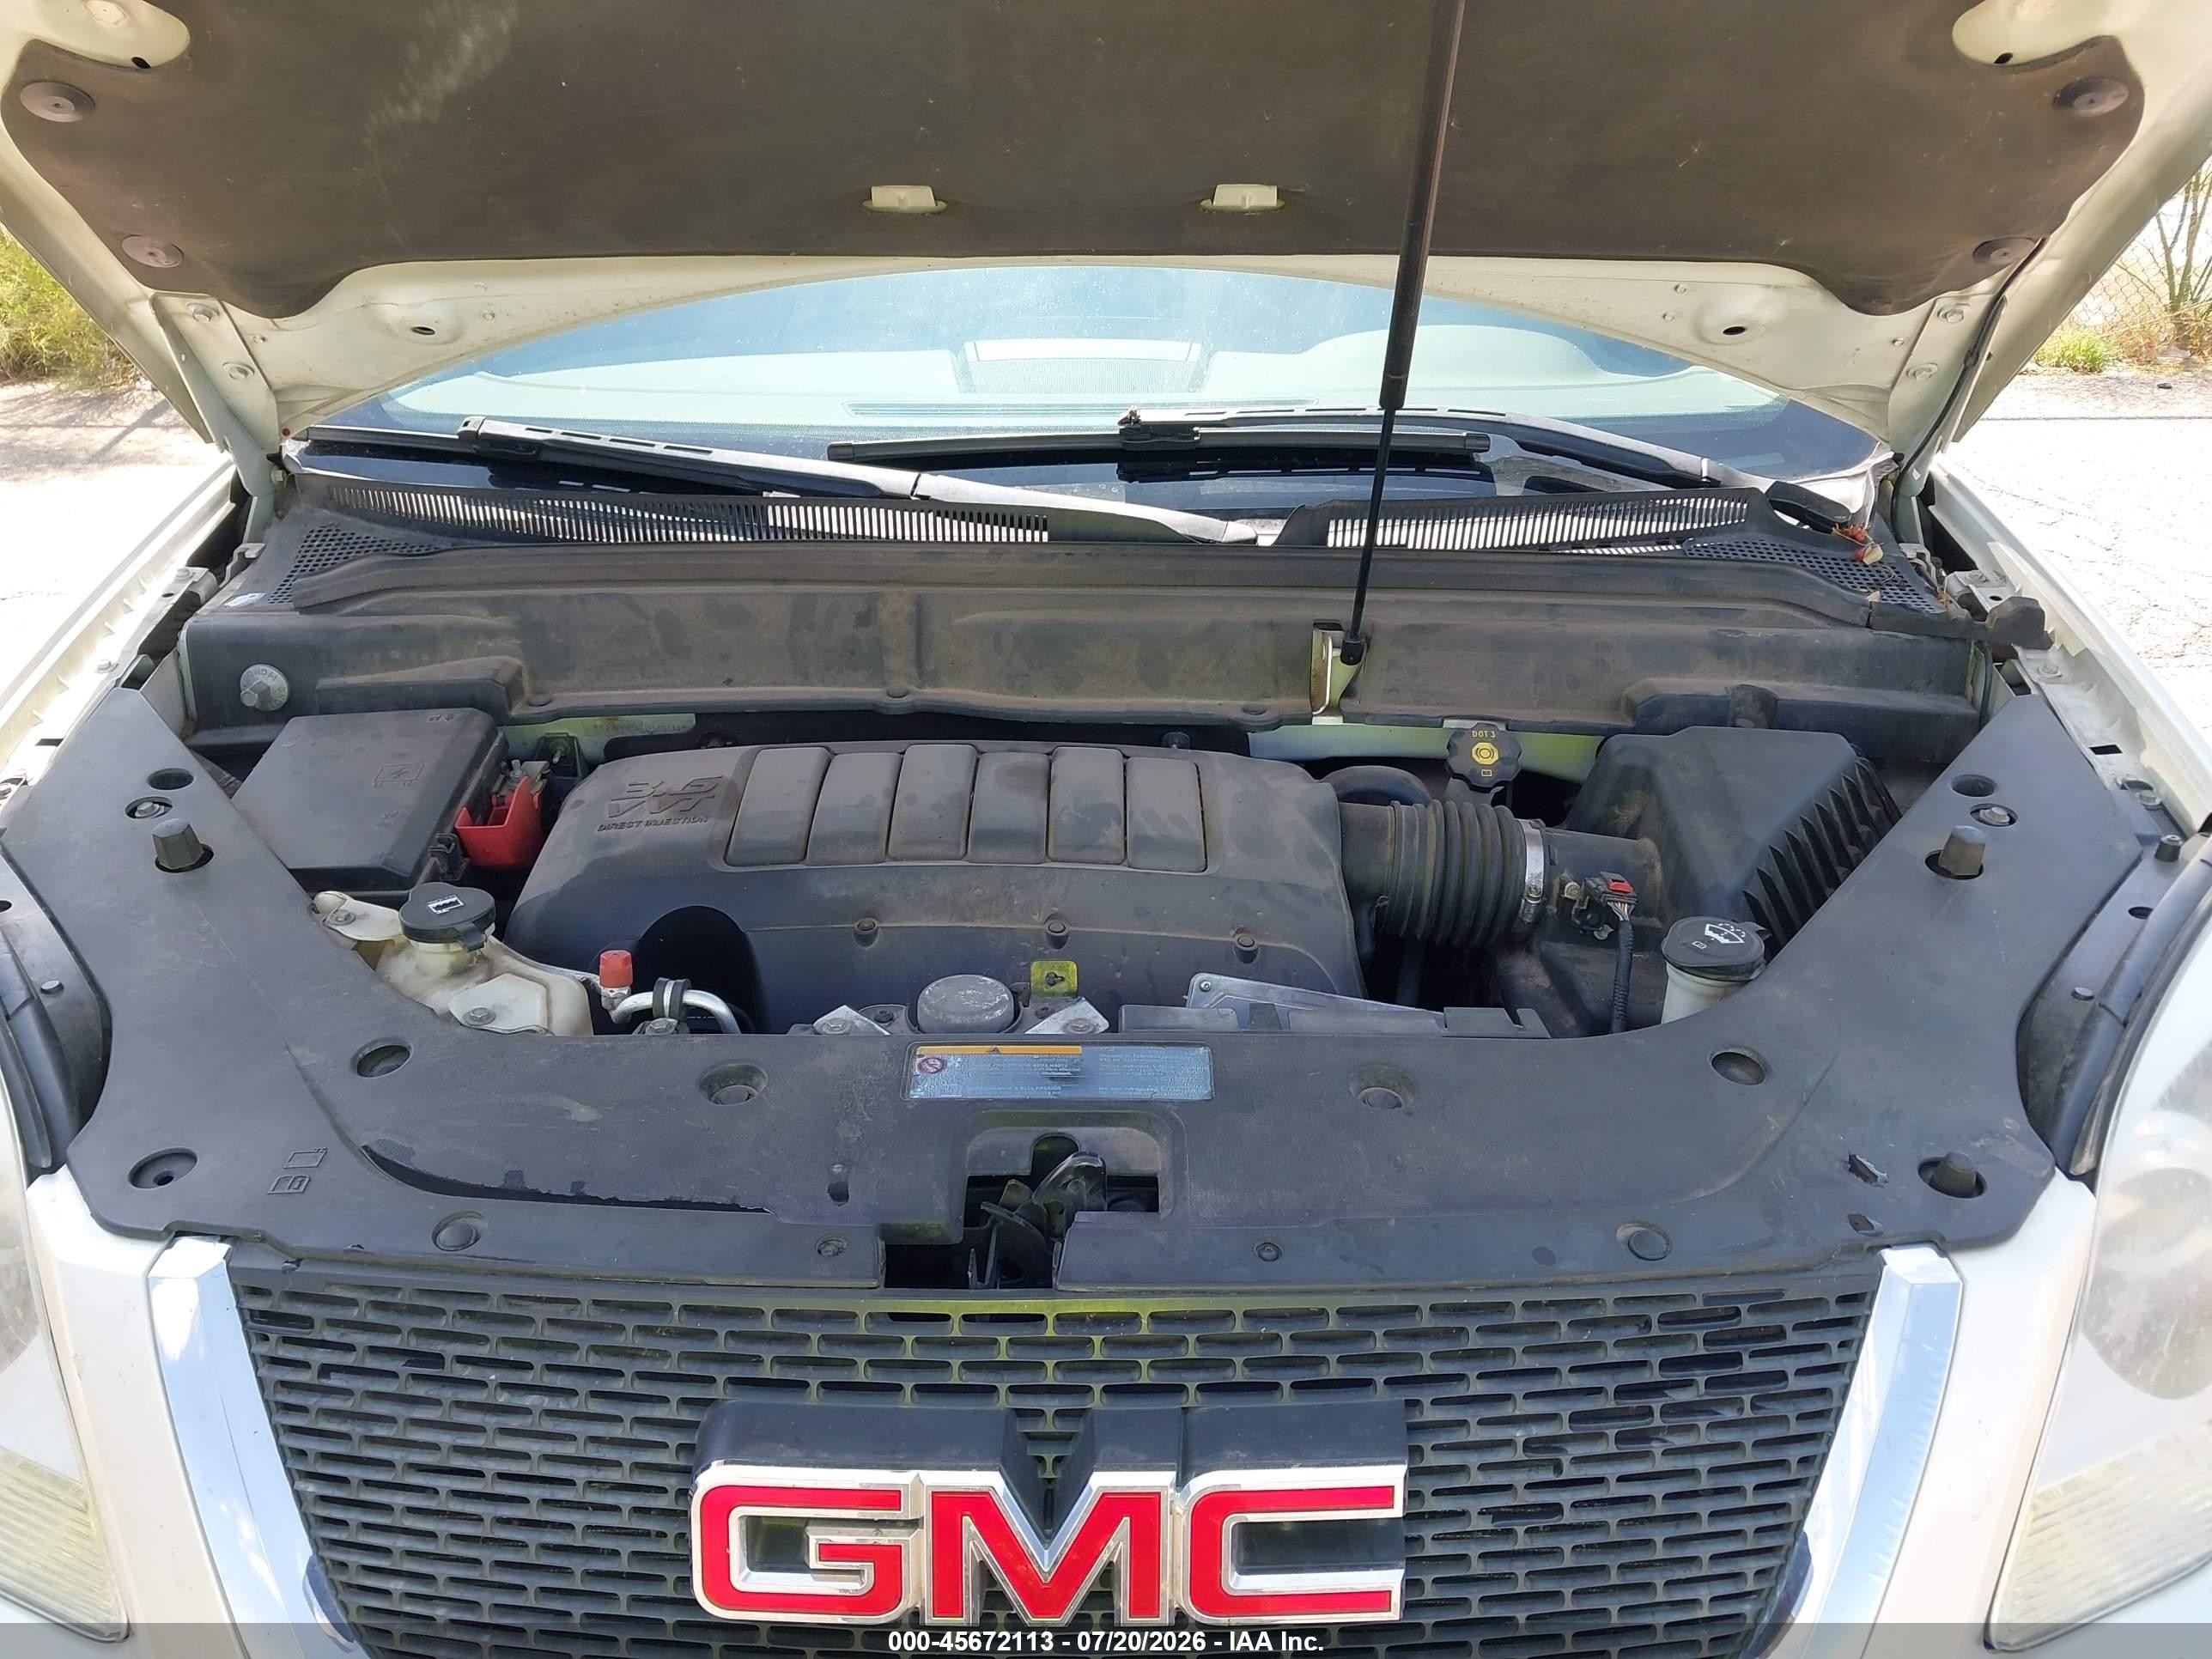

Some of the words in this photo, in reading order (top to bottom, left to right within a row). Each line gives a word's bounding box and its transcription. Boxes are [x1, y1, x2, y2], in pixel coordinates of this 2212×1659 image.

[1471, 730, 1488, 738] DOT
[1490, 730, 1496, 738] 3
[597, 819, 644, 832] DIRECT
[644, 817, 709, 829] INJECTION
[690, 1460, 1408, 1627] GMC
